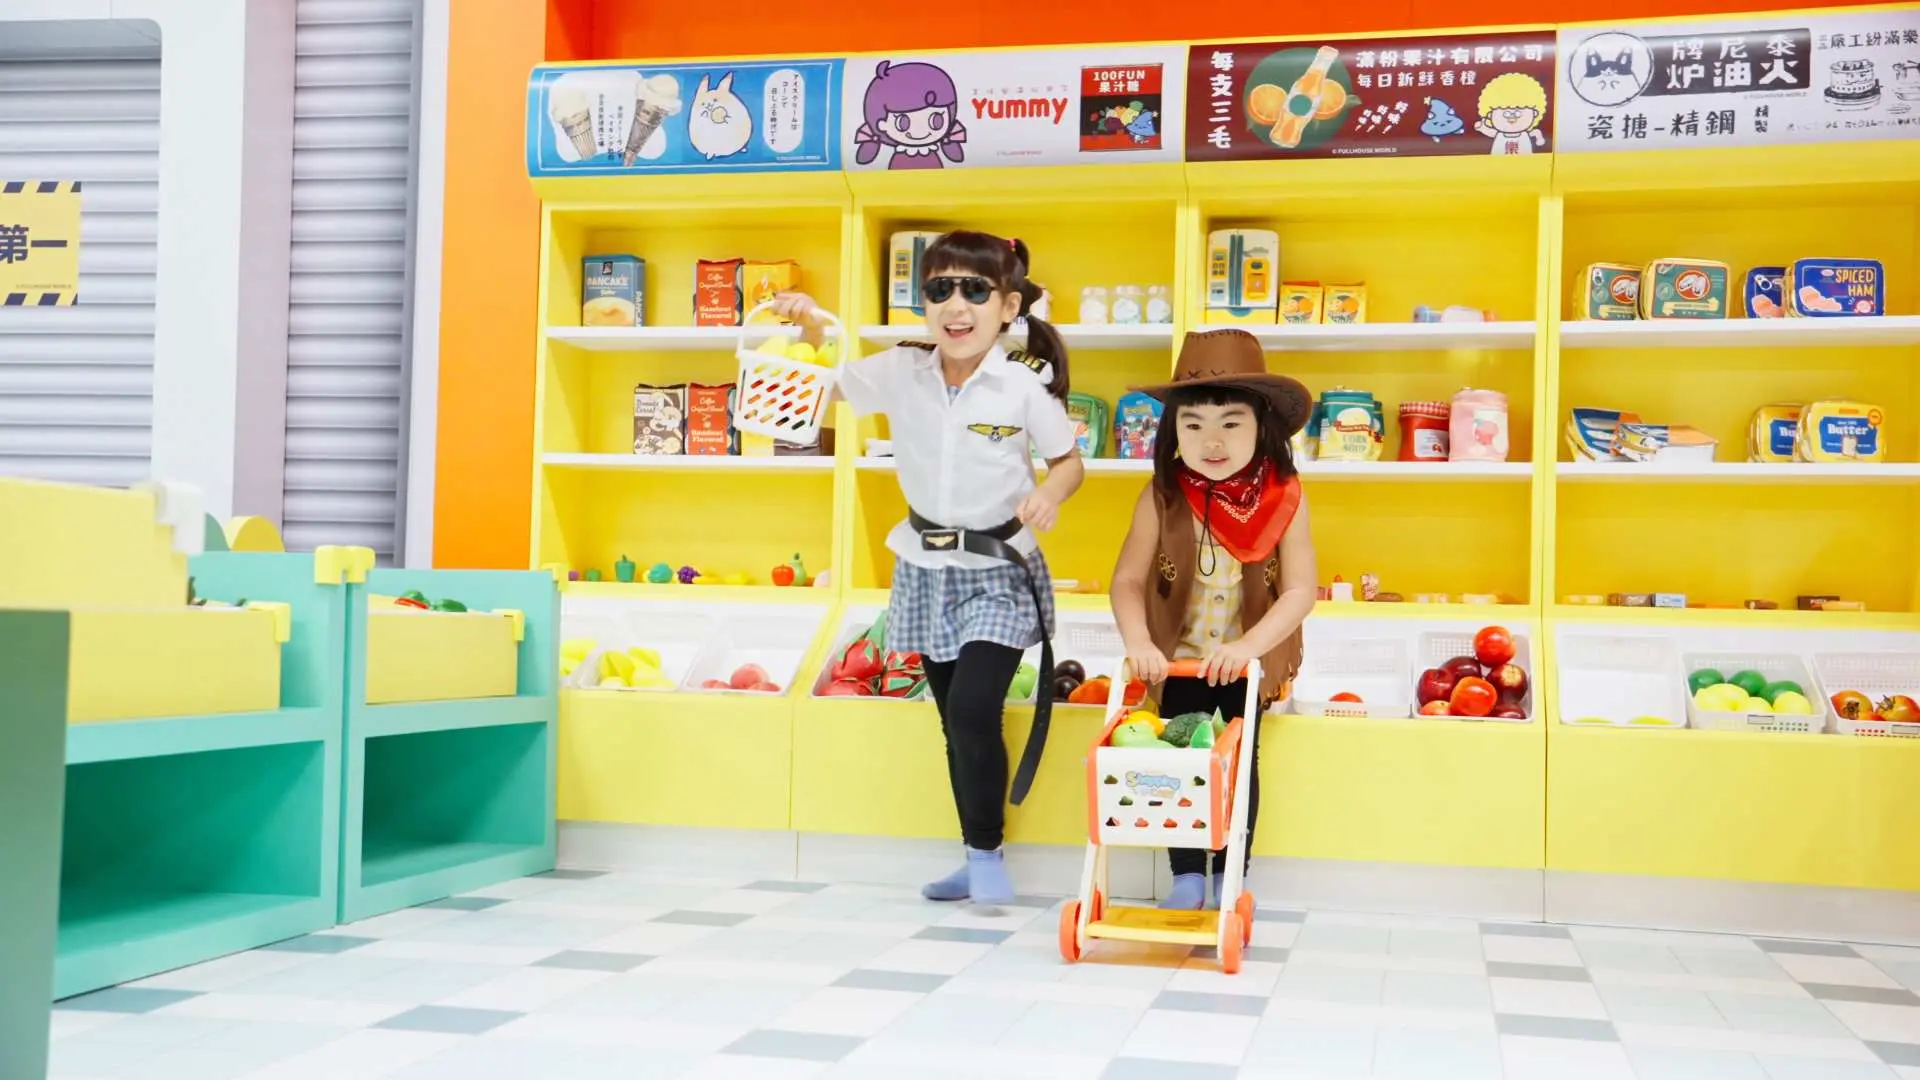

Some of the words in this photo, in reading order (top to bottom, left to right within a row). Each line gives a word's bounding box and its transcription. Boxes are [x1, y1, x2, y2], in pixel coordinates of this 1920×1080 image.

[1093, 70, 1146, 81] 100FUN
[1357, 71, 1477, 88] 每日新鮮香橙
[1207, 51, 1234, 149] 每支三毛
[971, 97, 1069, 125] Yummy
[0, 224, 67, 264] 第一
[586, 275, 630, 287] PANCAKE
[1835, 268, 1874, 283] SPICED
[1848, 283, 1874, 297] HAM
[1827, 423, 1869, 436] Butter
